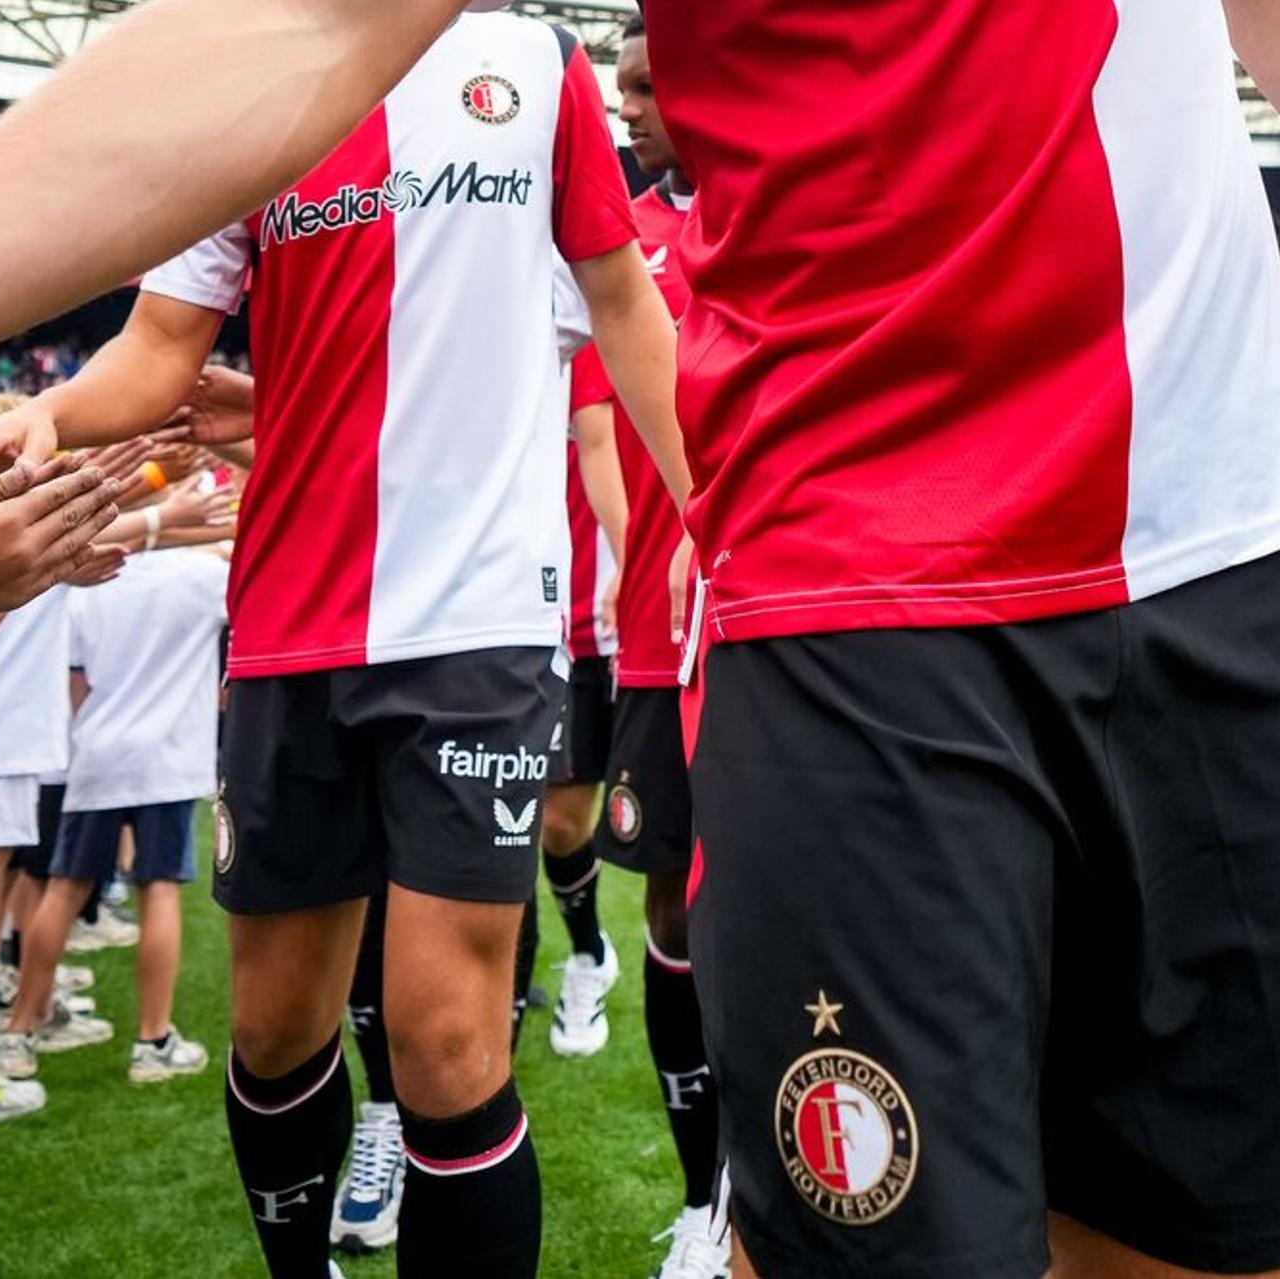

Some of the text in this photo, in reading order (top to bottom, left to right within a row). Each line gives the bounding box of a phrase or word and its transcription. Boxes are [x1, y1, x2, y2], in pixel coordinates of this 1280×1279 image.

[260, 161, 532, 251] Media Markt
[661, 1063, 710, 1109] F
[783, 1058, 898, 1112] FEYENOORD
[250, 1174, 324, 1223] F
[787, 1156, 910, 1218] ROTTERDAM
